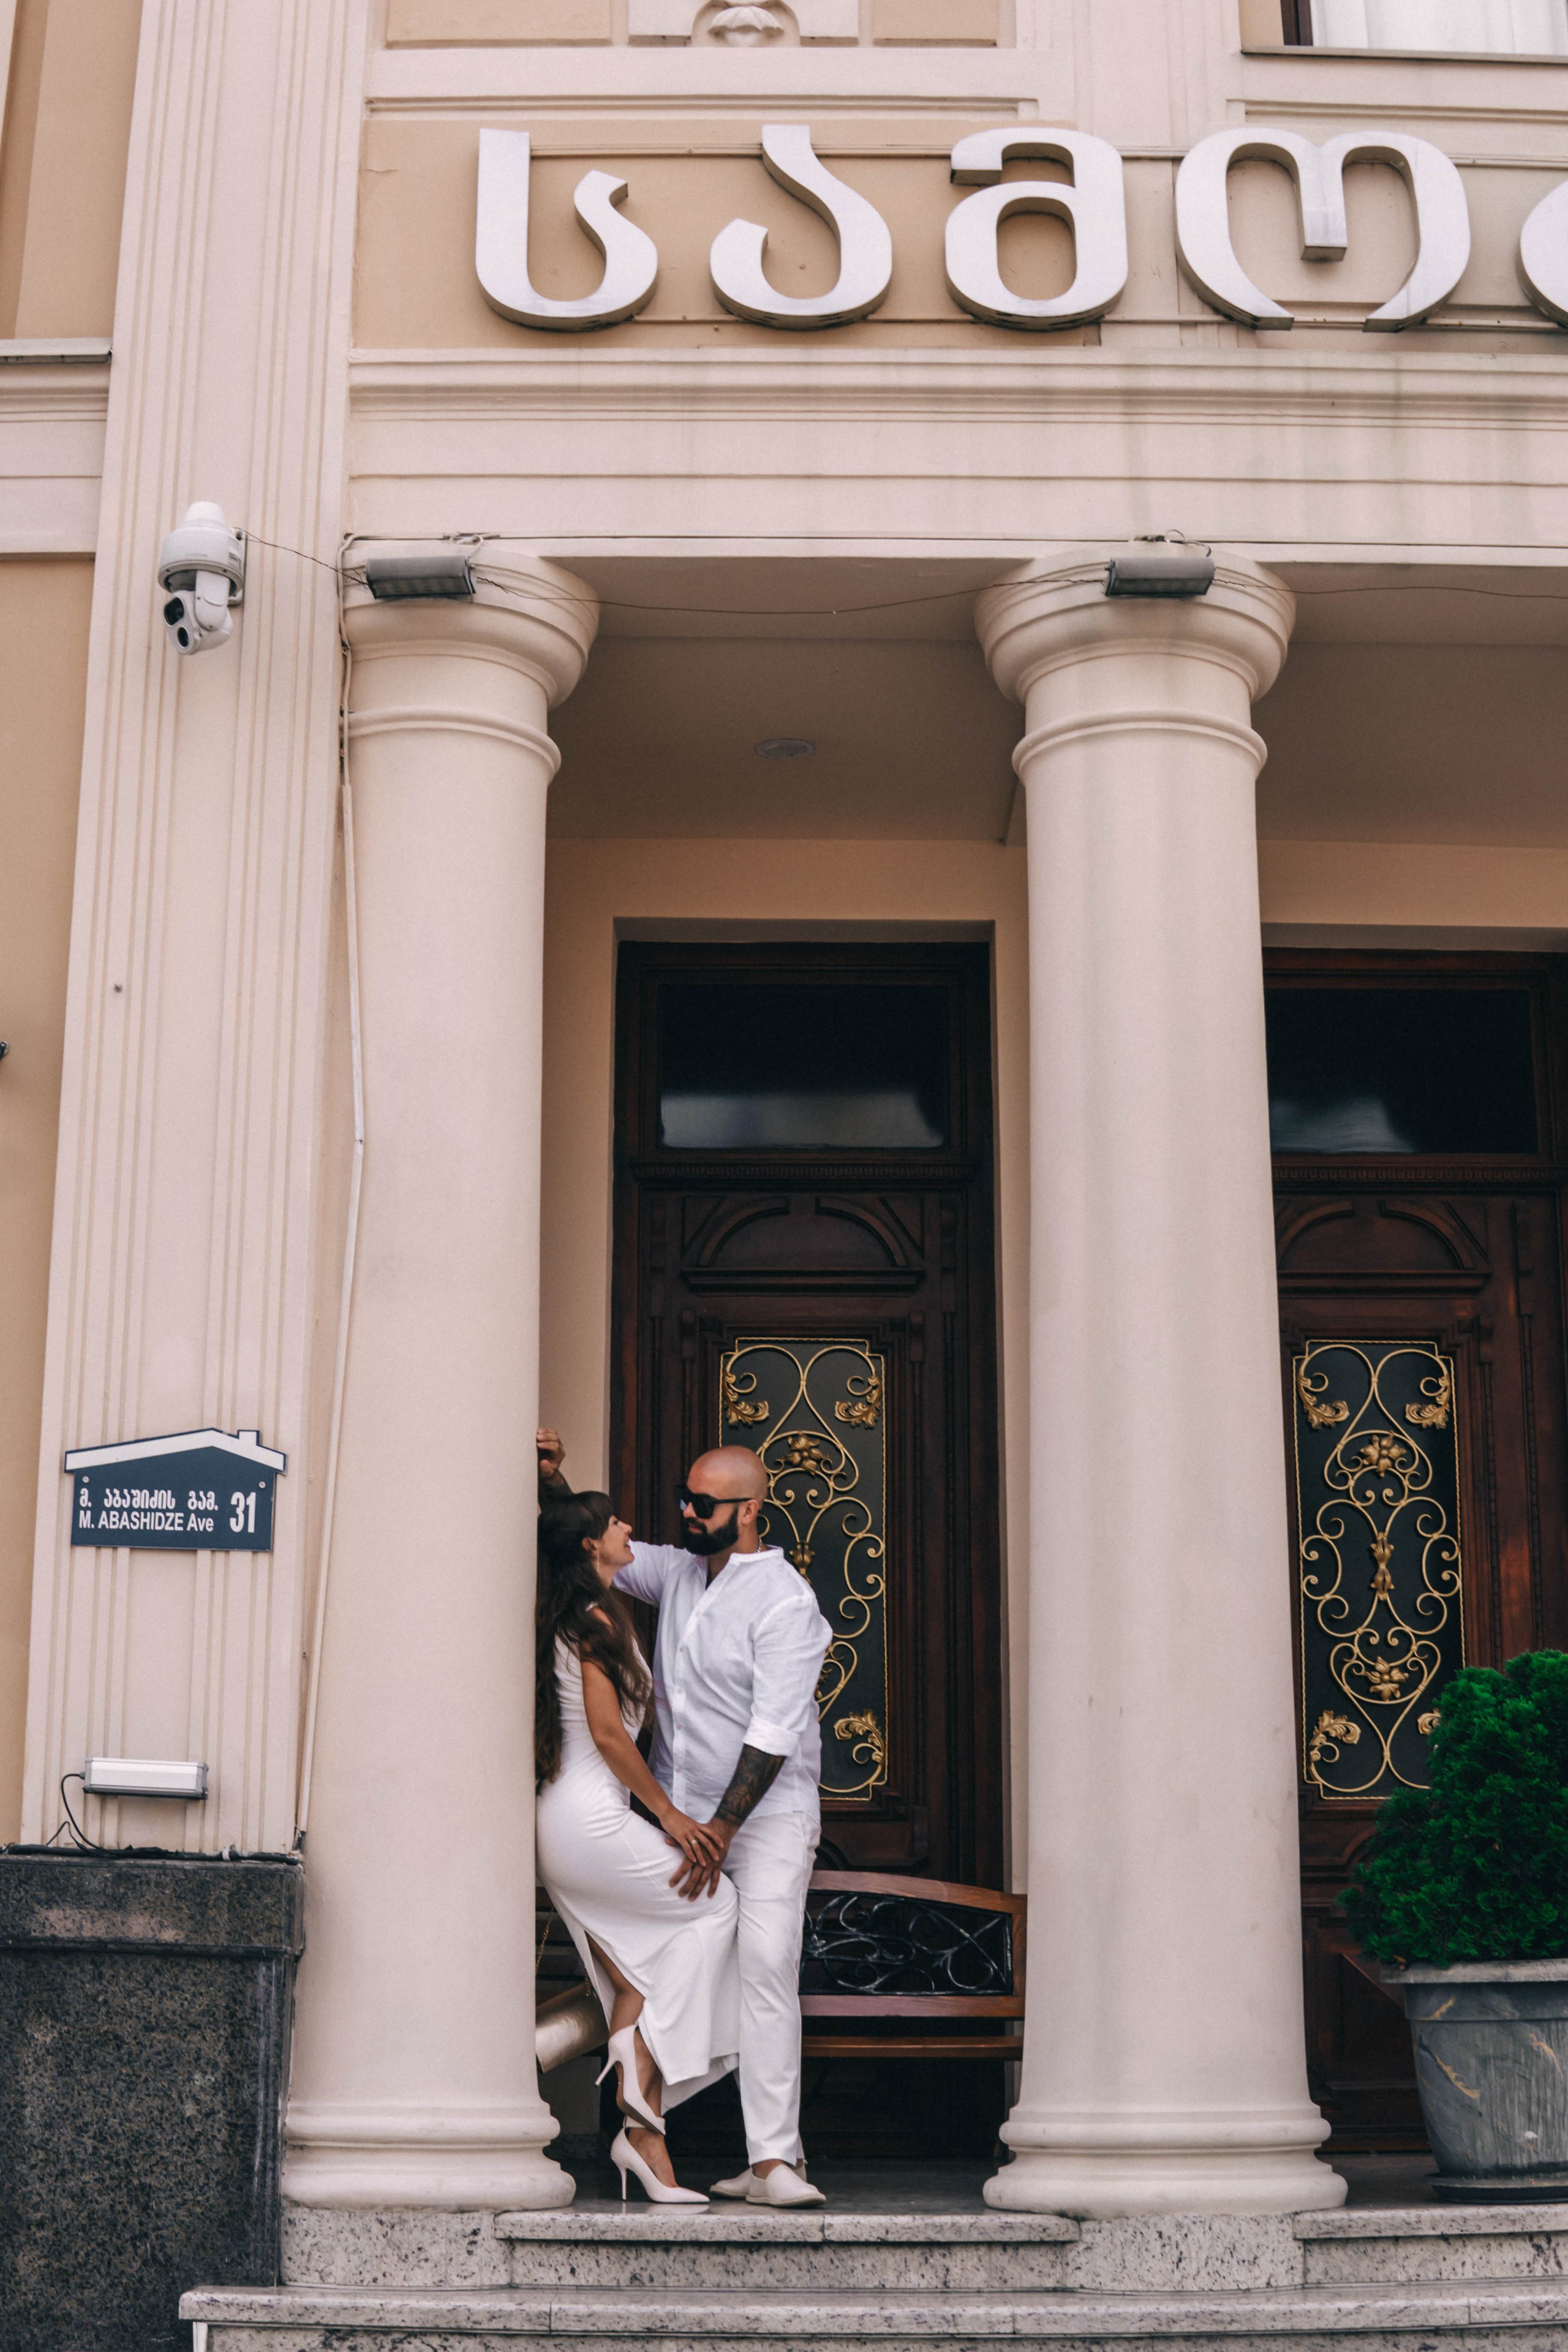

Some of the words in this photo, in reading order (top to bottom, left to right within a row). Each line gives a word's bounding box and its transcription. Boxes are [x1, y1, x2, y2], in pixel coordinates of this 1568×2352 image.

[475, 124, 1568, 331] სამო
[79, 1488, 92, 1507] მ.
[104, 1488, 176, 1509] აბაშიძის
[187, 1490, 219, 1511] გამ.
[230, 1491, 257, 1533] 31
[79, 1510, 95, 1529] M.
[97, 1510, 184, 1531] ABASHIDZE
[186, 1513, 214, 1532] Ave
